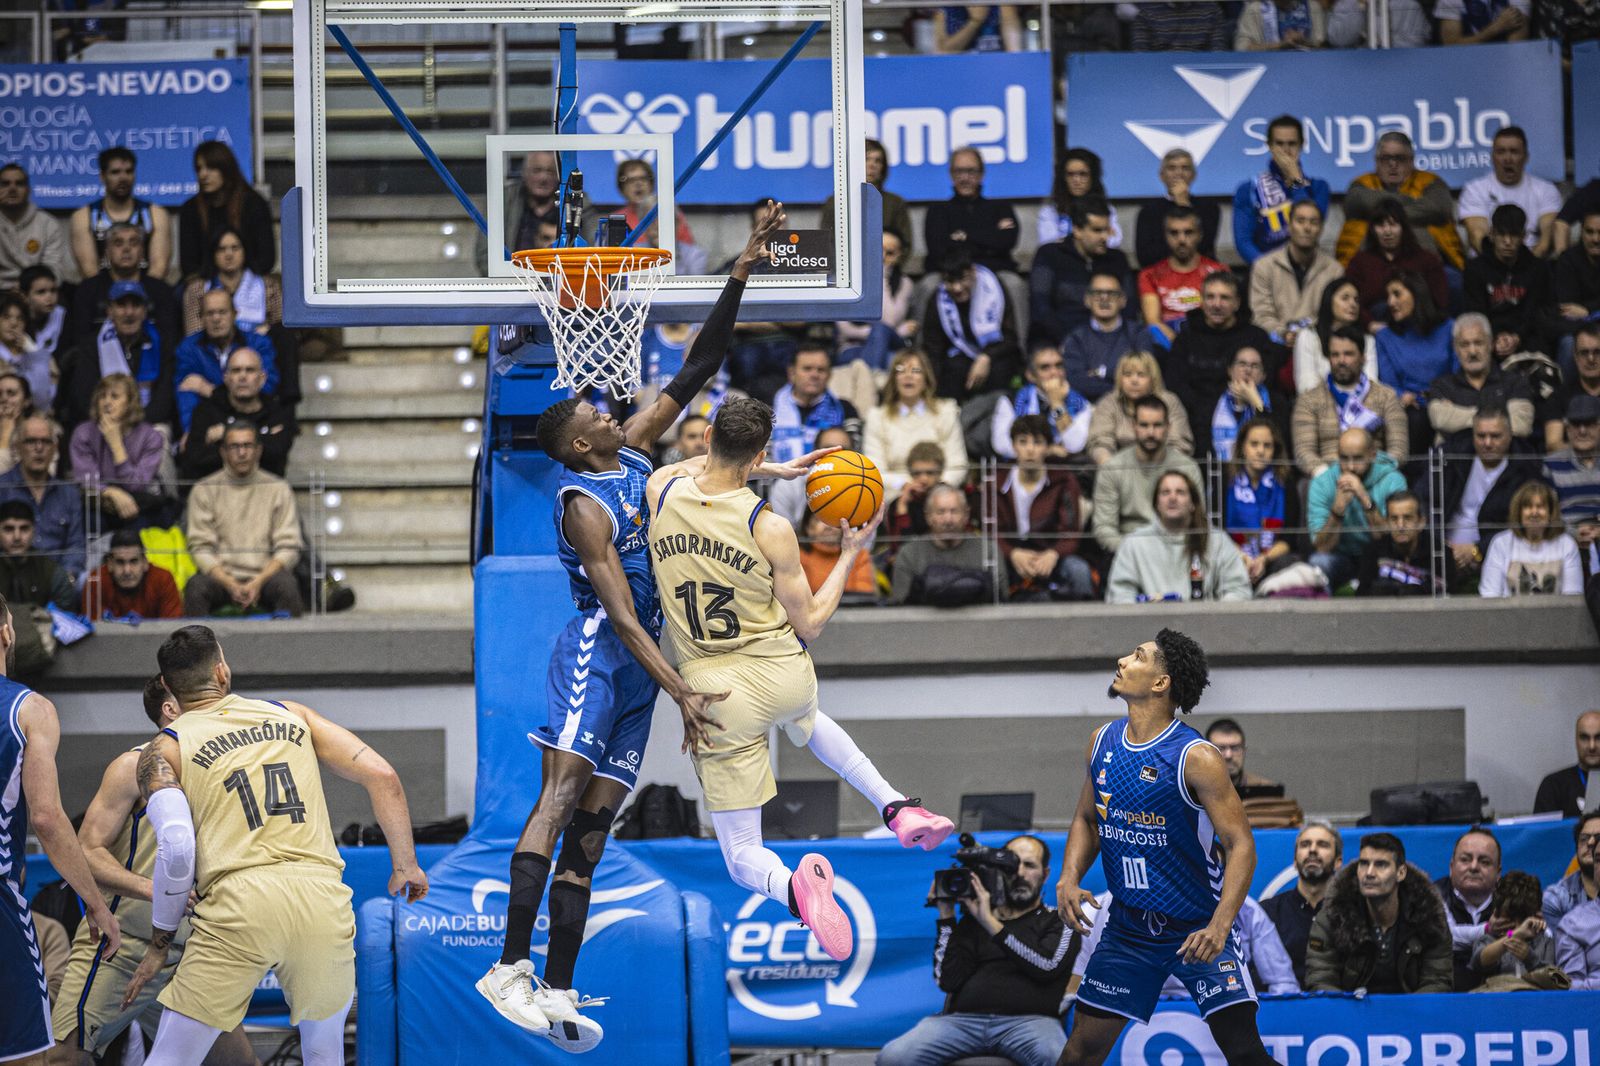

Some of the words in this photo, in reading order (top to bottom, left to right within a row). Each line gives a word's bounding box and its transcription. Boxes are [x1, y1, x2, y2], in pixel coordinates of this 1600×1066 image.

[103, 129, 122, 147] Y
[696, 84, 1028, 170] hummel
[1243, 97, 1512, 167] SNpablo
[1414, 152, 1494, 171] OBILIAR
[770, 240, 797, 256] liga
[770, 255, 828, 267] endesa
[654, 533, 758, 576] SATORANSKY
[675, 580, 742, 642] 13
[191, 719, 306, 770] HERNANGÓMEZ
[223, 762, 308, 832] 14
[1104, 824, 1157, 846] BURGOS
[1122, 855, 1150, 890] 00
[747, 963, 841, 981] residuos
